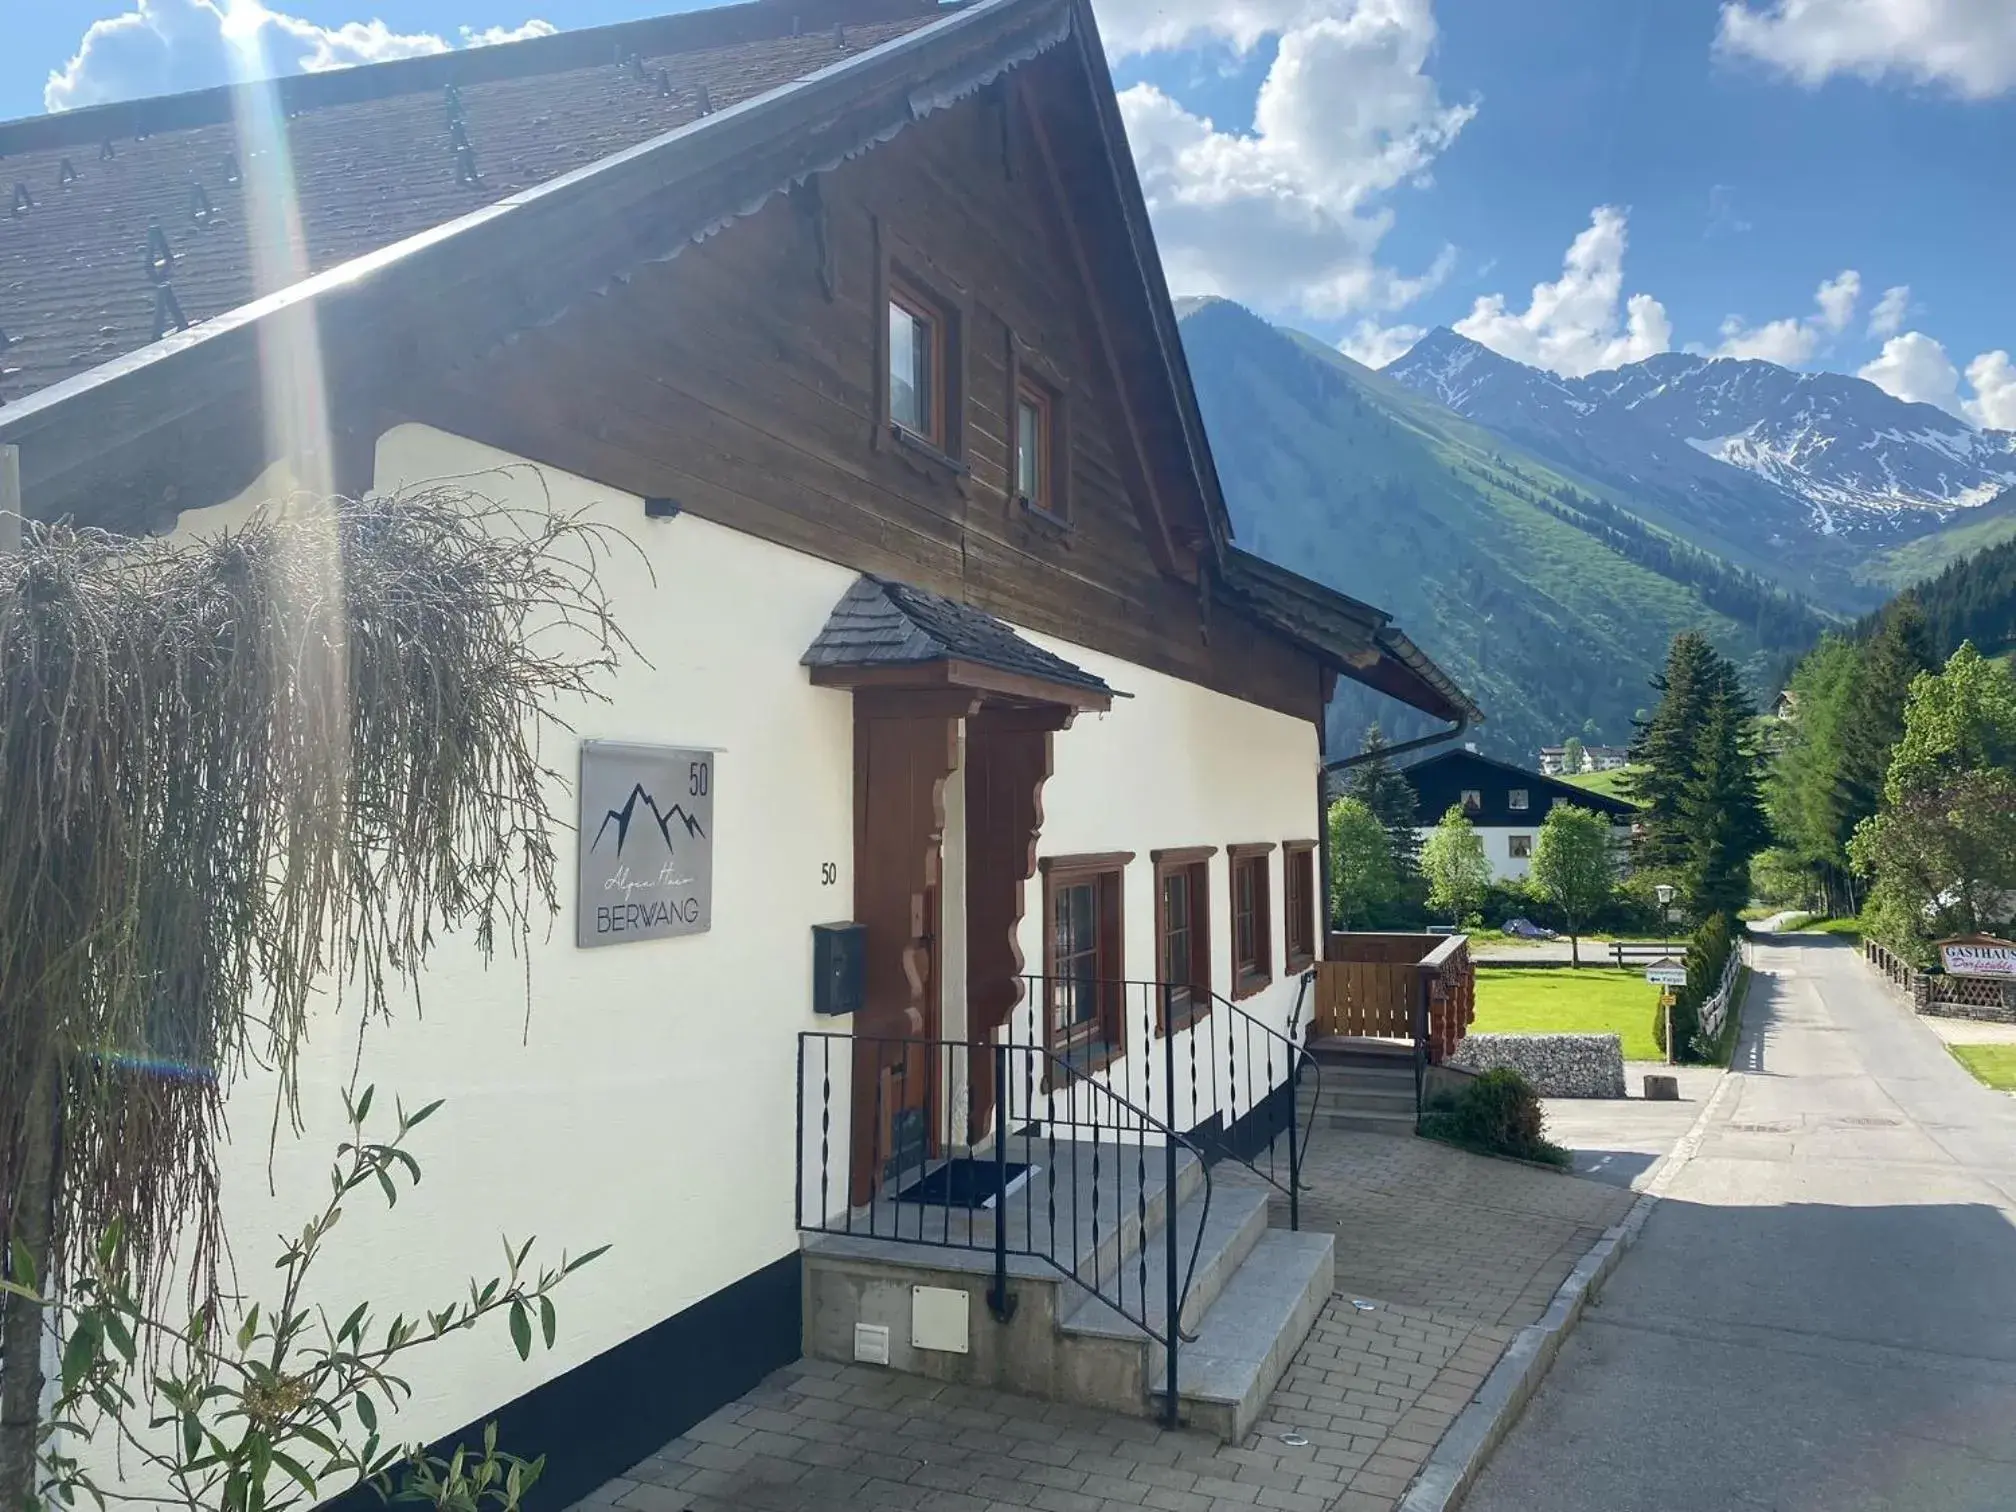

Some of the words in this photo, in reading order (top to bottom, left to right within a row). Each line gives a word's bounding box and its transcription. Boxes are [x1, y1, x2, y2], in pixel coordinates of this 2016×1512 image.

[690, 762, 708, 796] 50
[821, 862, 837, 886] 50
[597, 897, 699, 933] BERWANG
